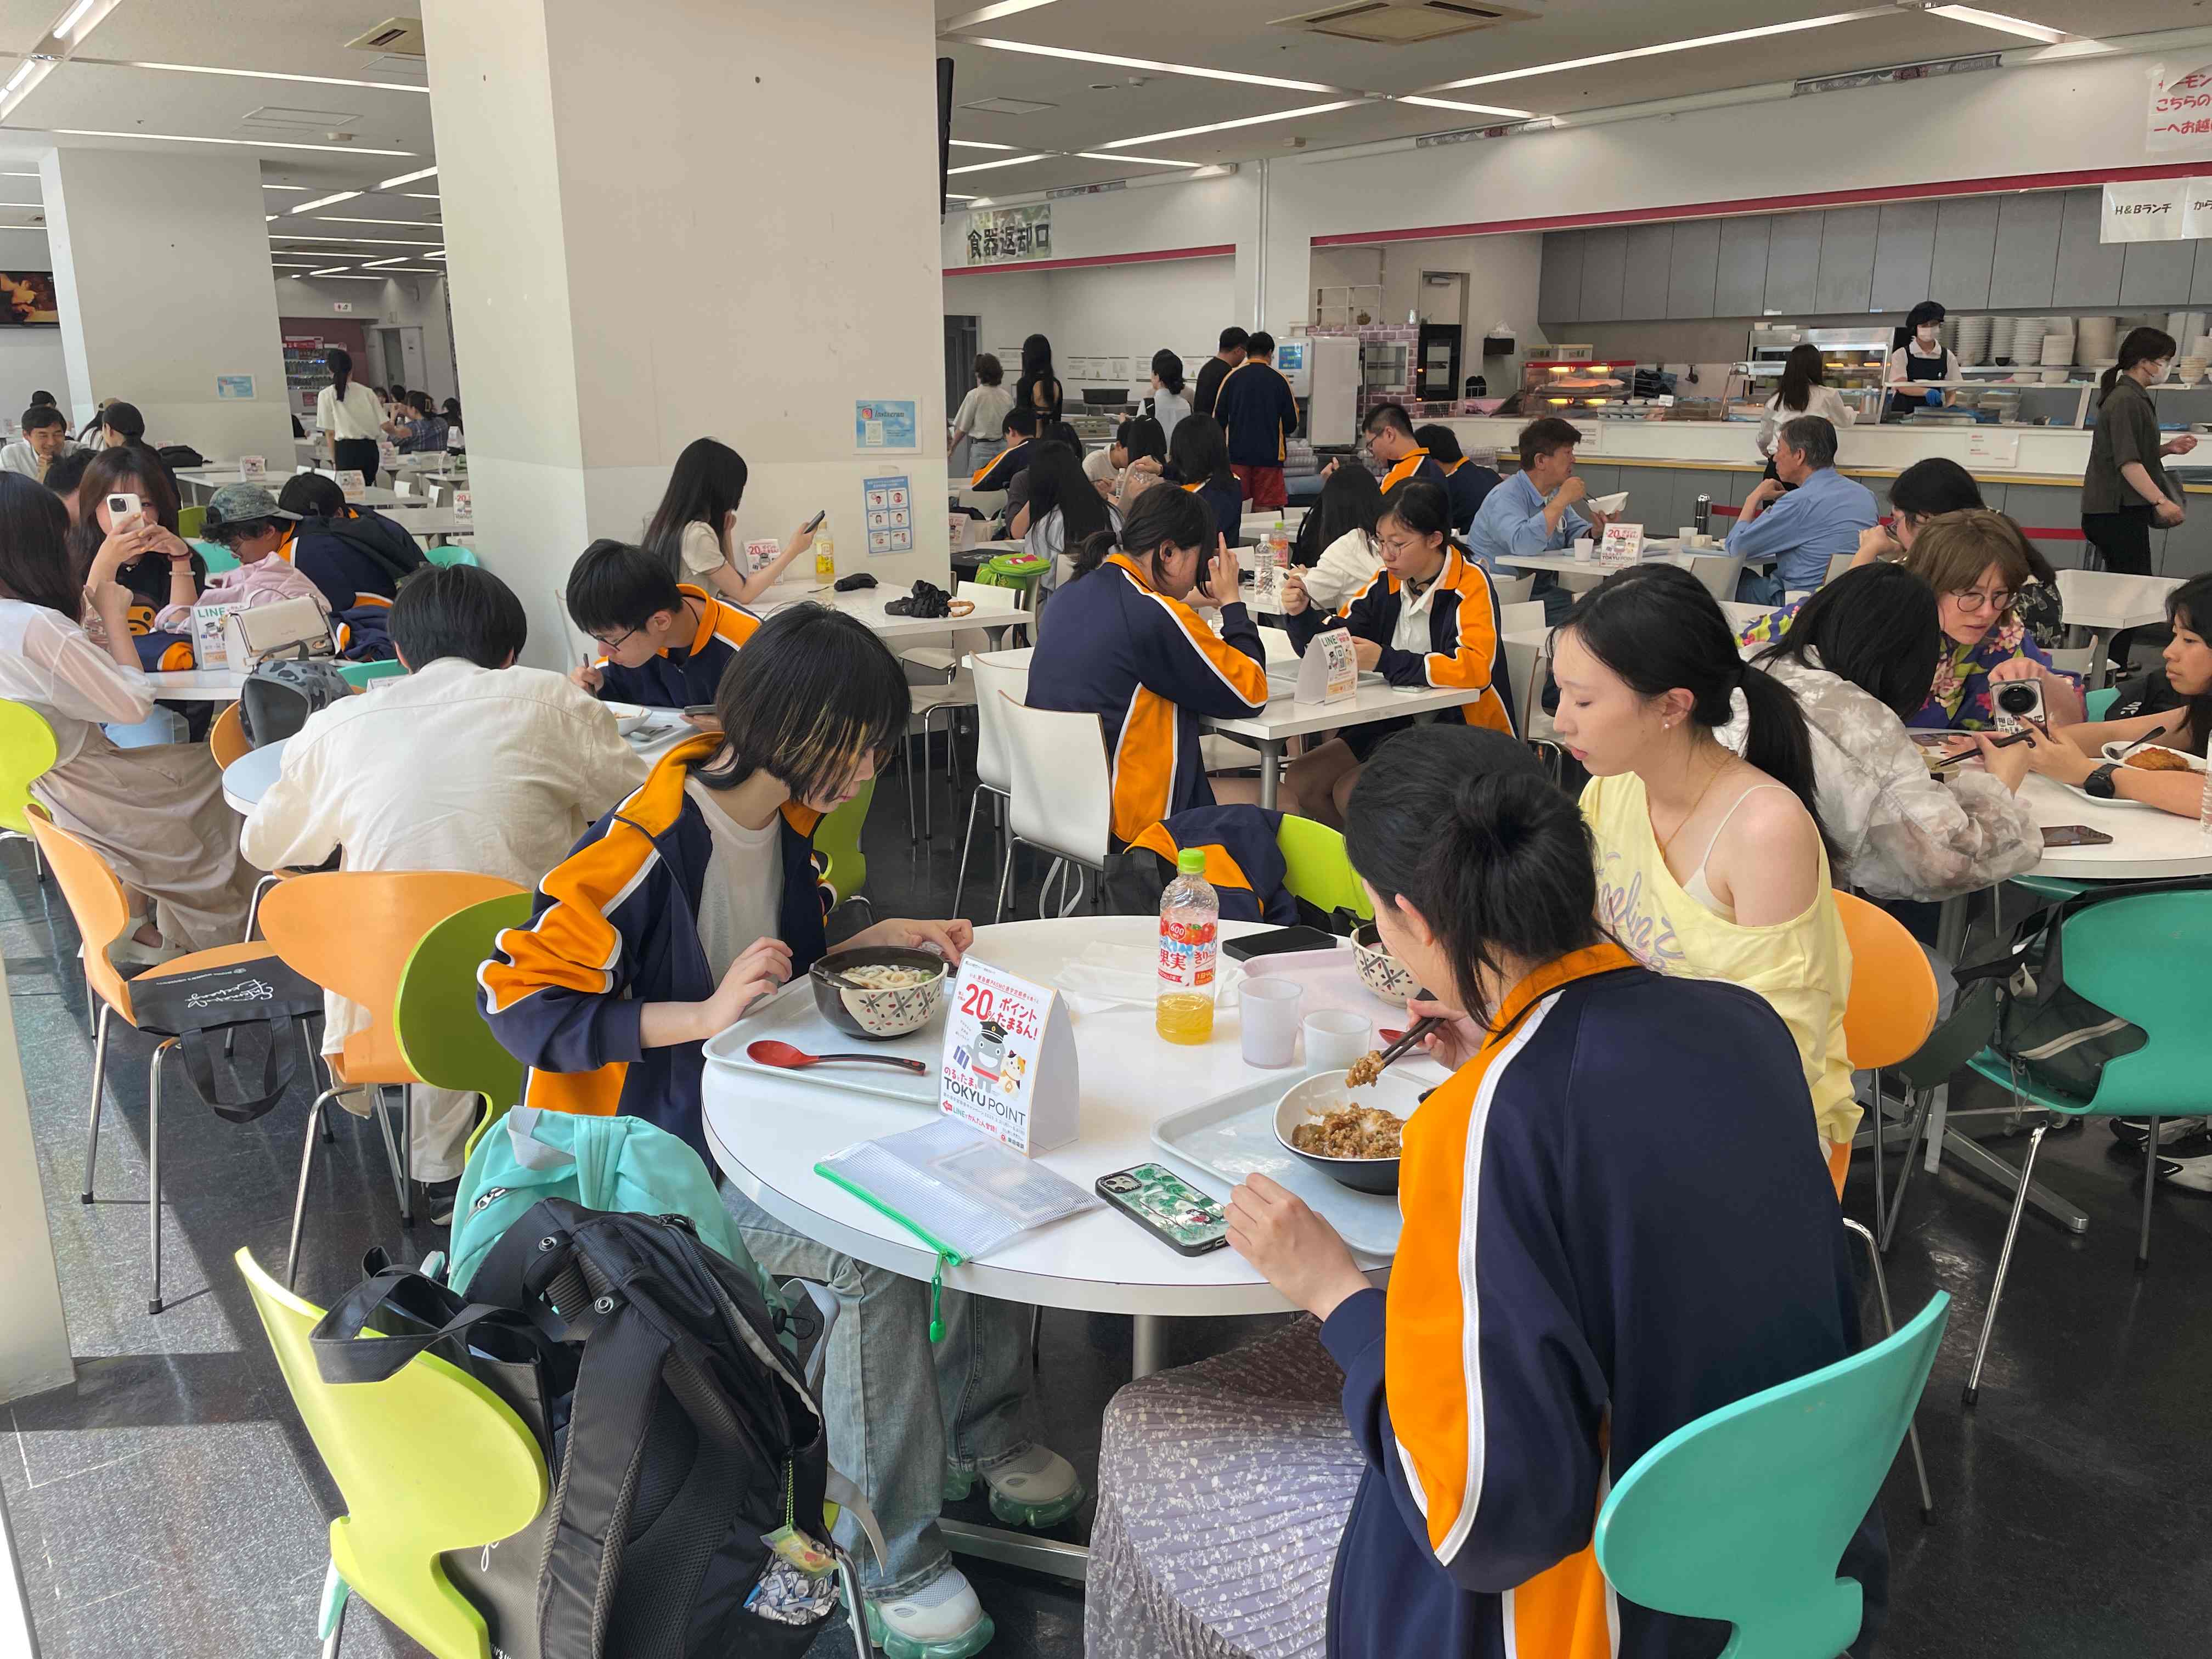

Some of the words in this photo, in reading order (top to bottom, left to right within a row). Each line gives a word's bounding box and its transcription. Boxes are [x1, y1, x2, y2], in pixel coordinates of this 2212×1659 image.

[2156, 94, 2211, 111] こちらの
[2115, 203, 2172, 215] H&Bランチ
[968, 223, 1049, 259] 食器返却口
[1170, 925, 1185, 936] 600
[1160, 947, 1187, 970] 果実
[999, 997, 1037, 1023] ポイント
[944, 1076, 986, 1107] TOKYU
[988, 1097, 1026, 1126] POINT
